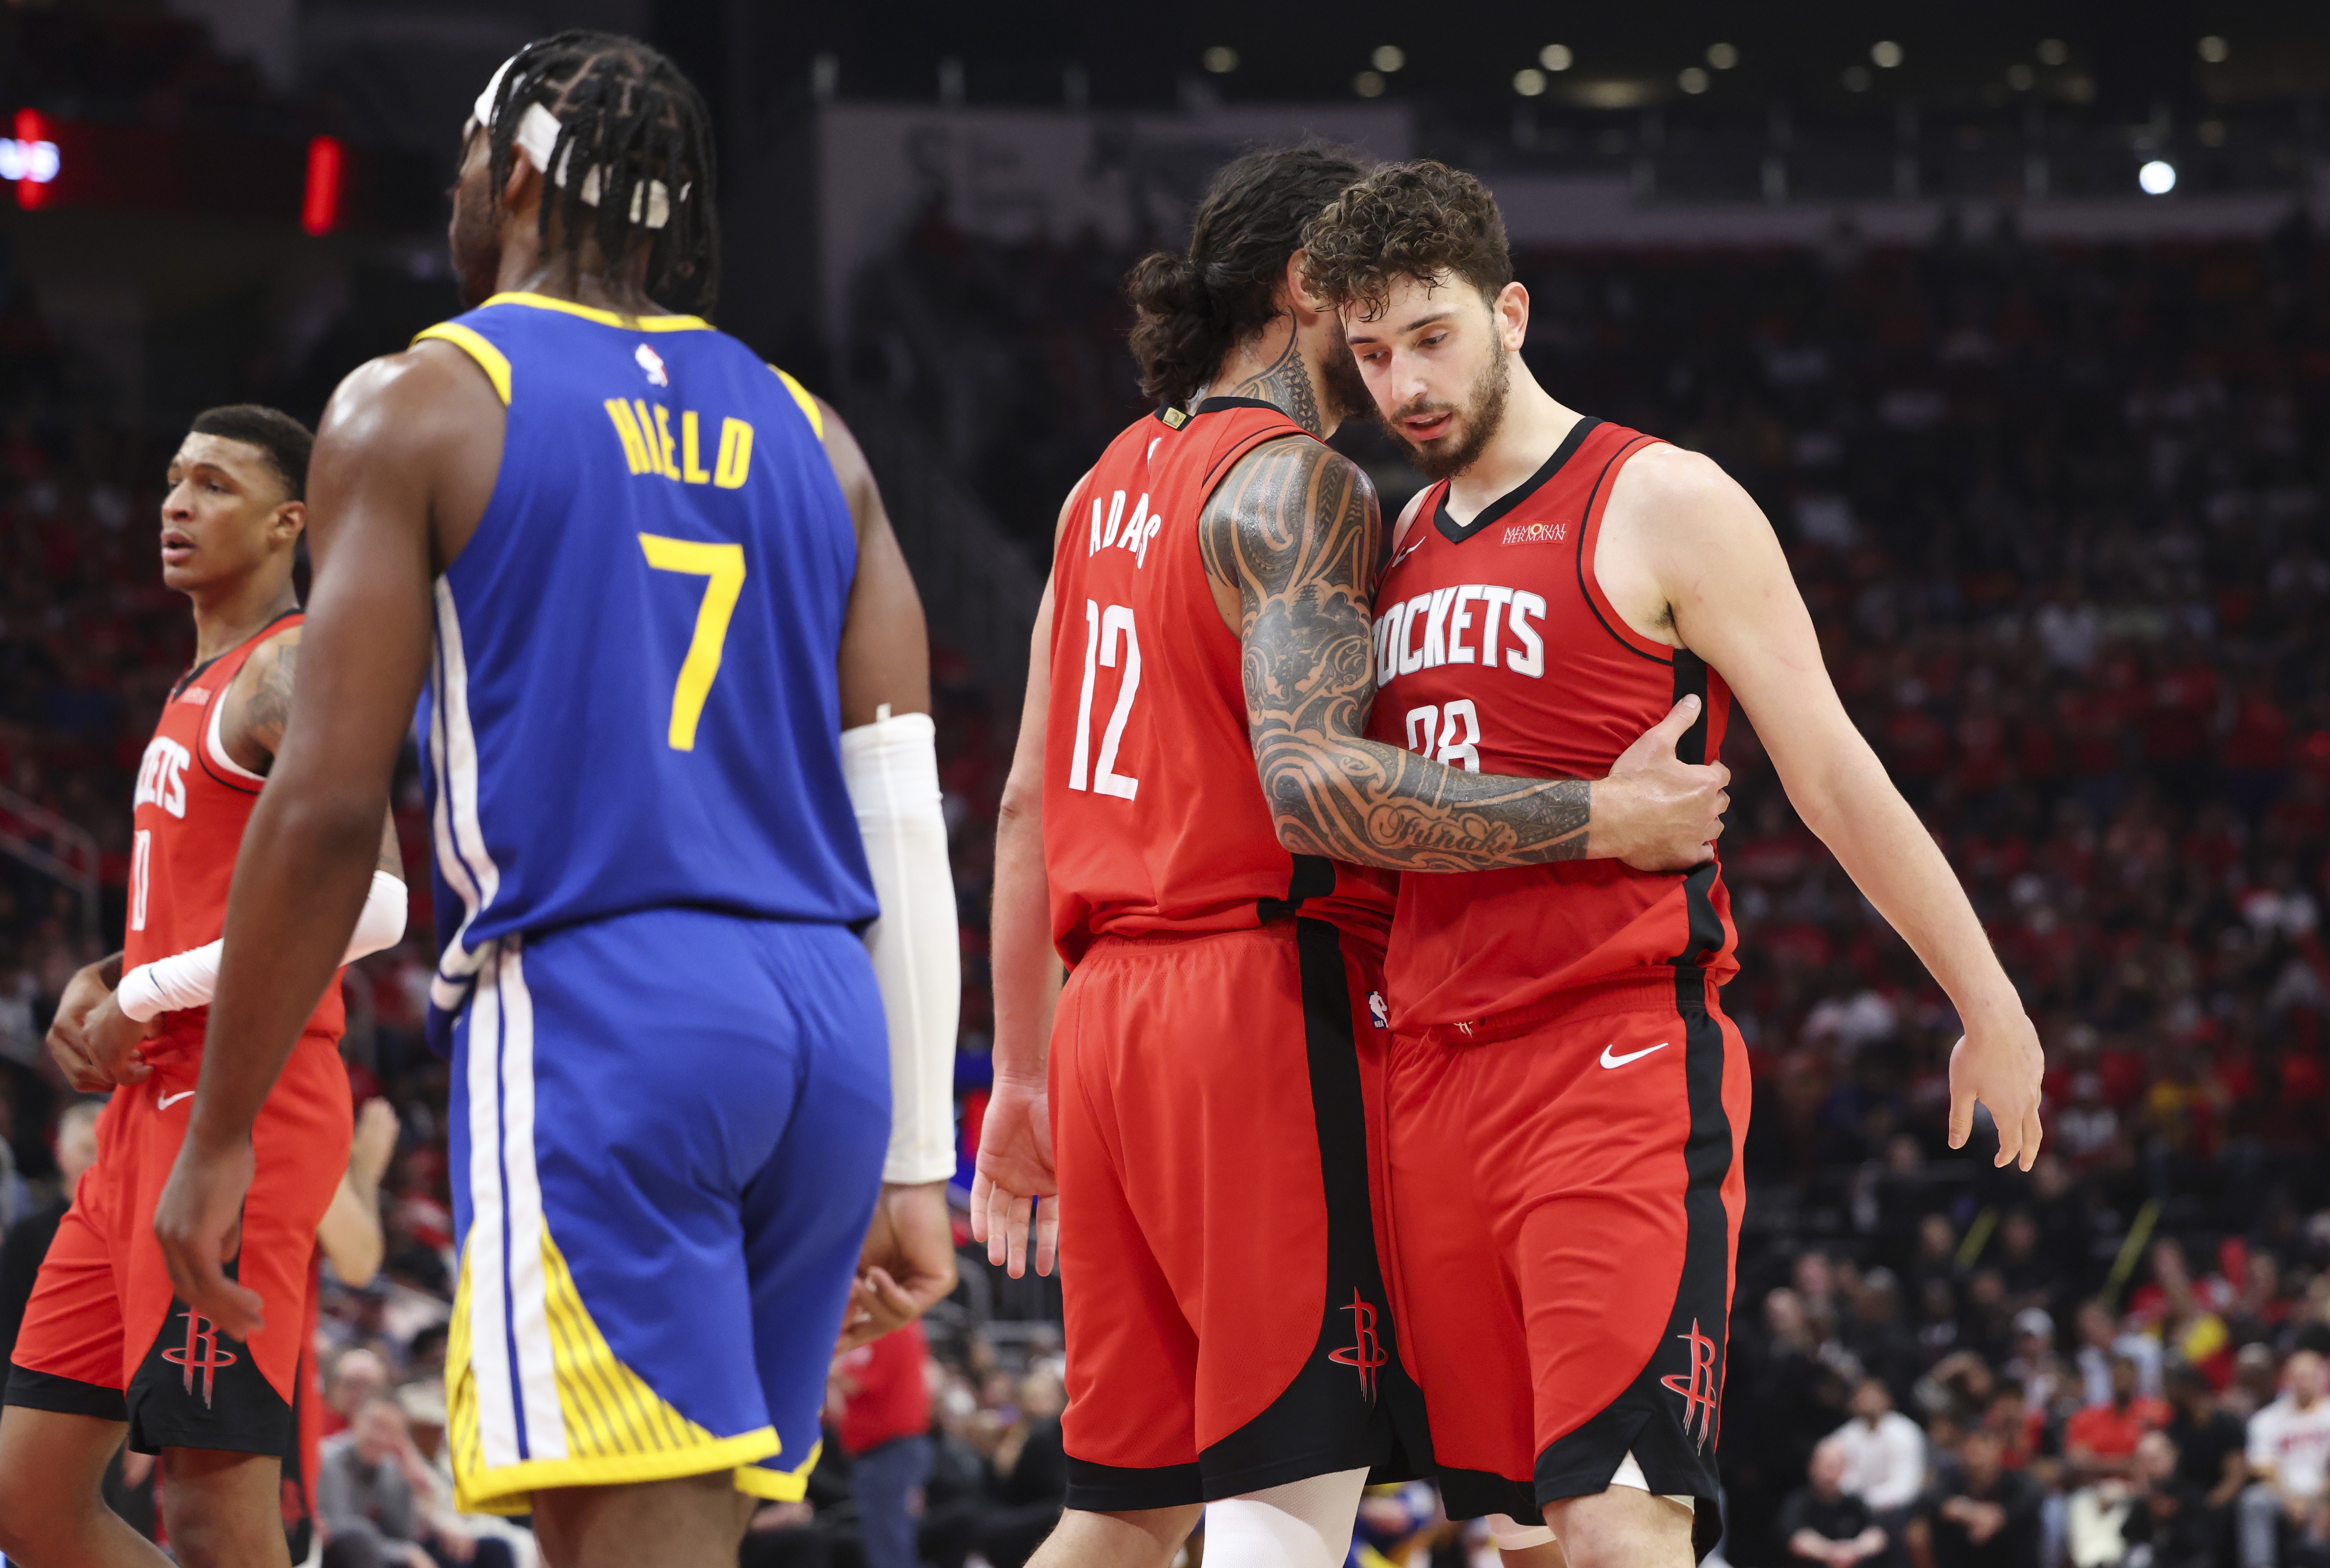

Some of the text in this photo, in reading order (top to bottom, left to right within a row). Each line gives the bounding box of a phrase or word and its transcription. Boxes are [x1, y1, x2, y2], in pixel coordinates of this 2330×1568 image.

[604, 398, 754, 489] HIELD
[1089, 490, 1162, 569] ADAS
[1502, 531, 1566, 544] HERMANN
[1505, 523, 1566, 536] MEMORIAL
[637, 532, 746, 751] 7
[1069, 598, 1141, 802] 12
[1374, 1020, 1384, 1028] NBA
